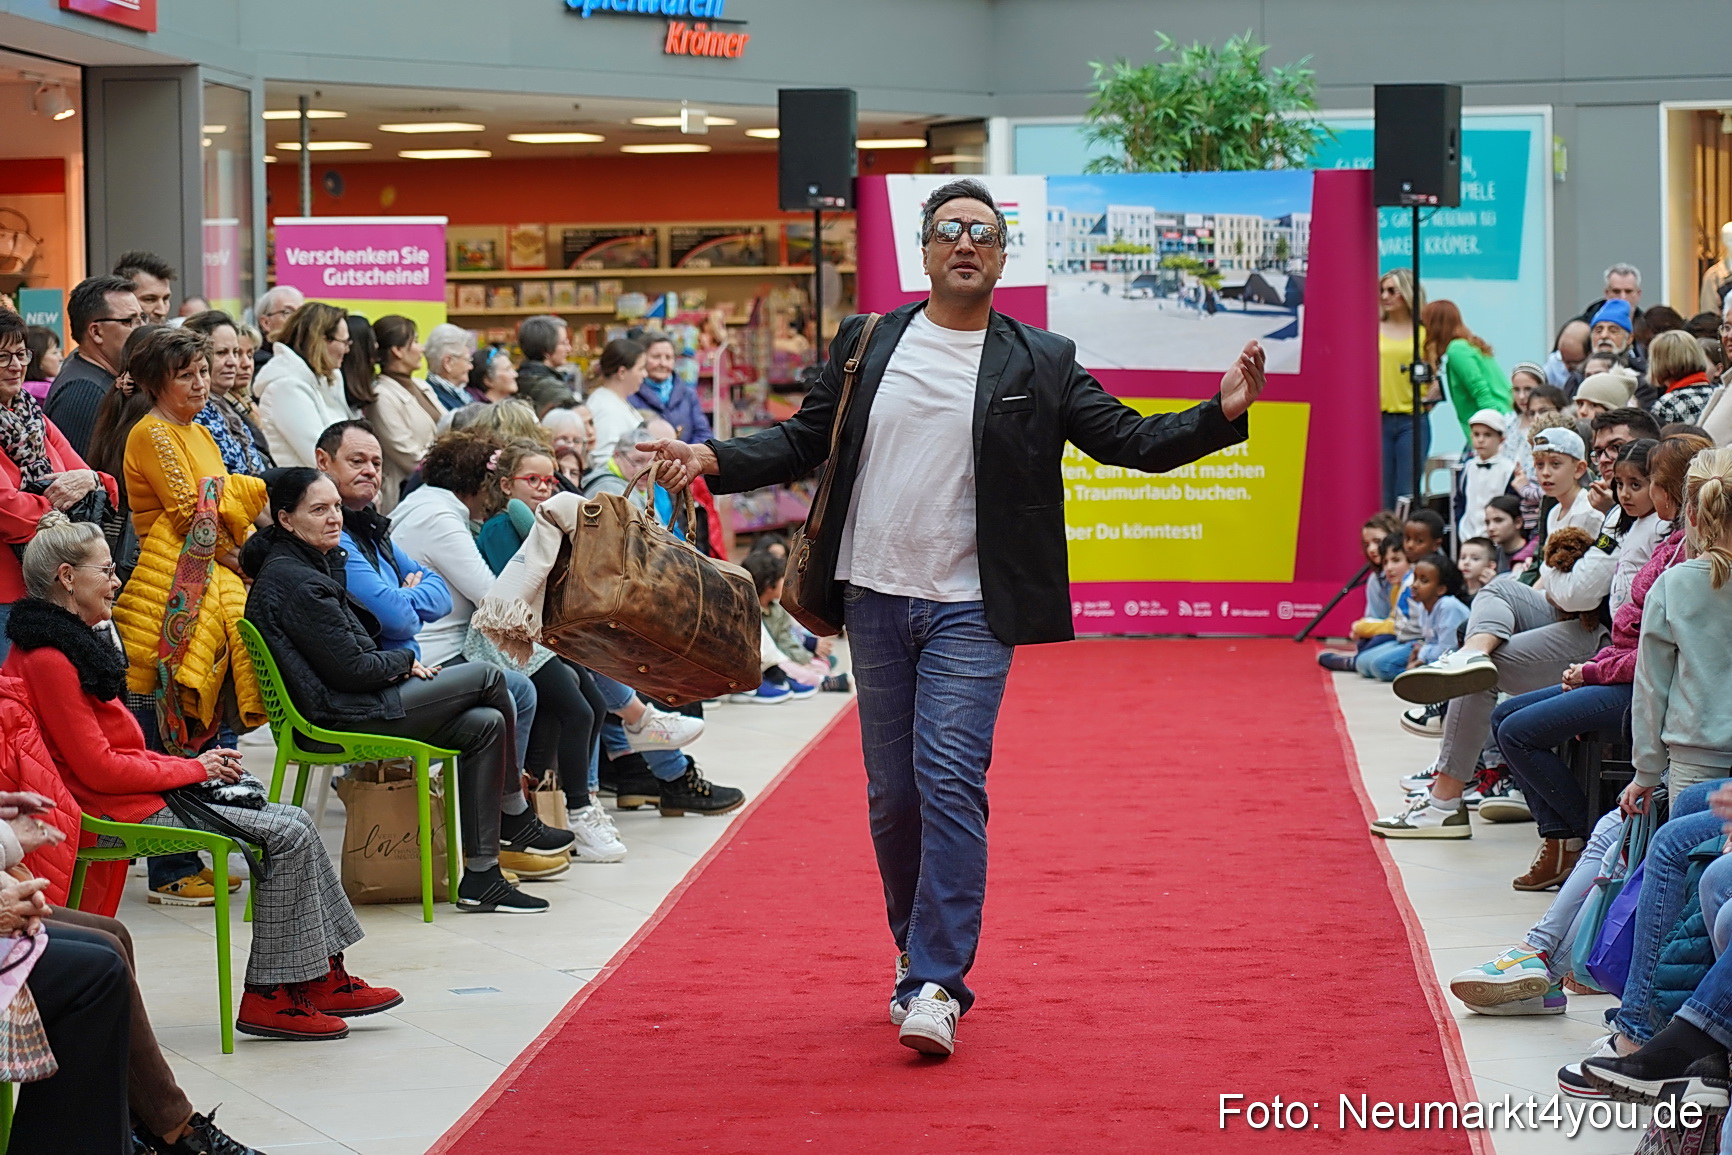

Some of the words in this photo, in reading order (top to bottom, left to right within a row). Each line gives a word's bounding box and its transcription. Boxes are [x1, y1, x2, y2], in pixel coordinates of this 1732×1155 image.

[566, 0, 725, 19] pewaren
[665, 21, 750, 58] Krömer
[285, 247, 399, 266] Verschenken
[401, 246, 430, 265] Sie
[323, 267, 430, 286] Gutscheine!
[26, 311, 59, 325] NEW
[1095, 464, 1122, 479] ein
[1126, 463, 1196, 479] Wout
[1200, 463, 1265, 479] machen
[1074, 484, 1182, 502] Traumurlaub
[1184, 484, 1252, 501] buchen.
[1065, 524, 1092, 540] ber
[1095, 523, 1120, 540] Du
[1122, 522, 1203, 540] könntest!
